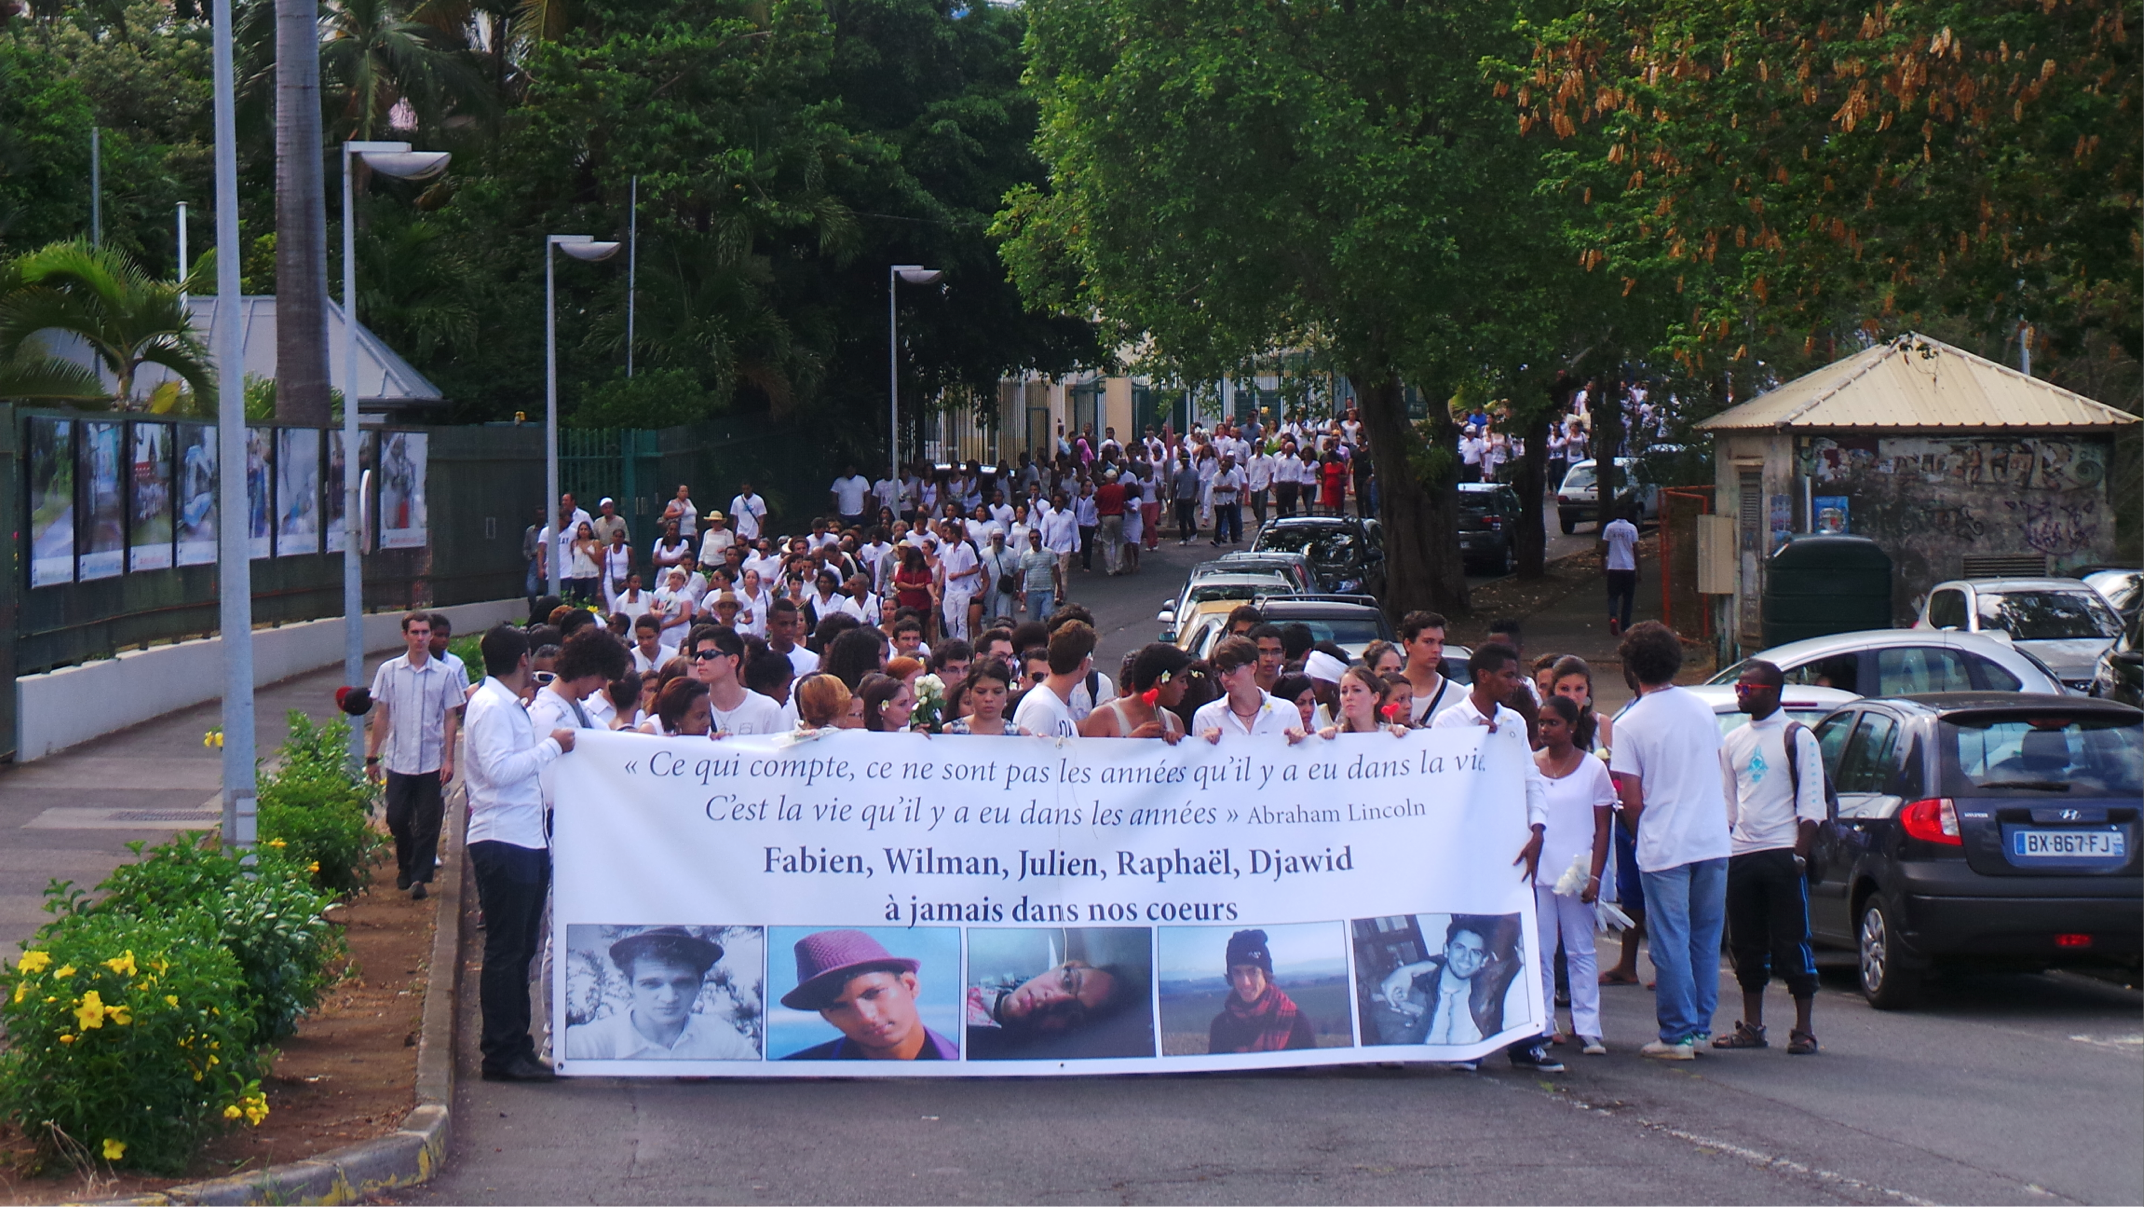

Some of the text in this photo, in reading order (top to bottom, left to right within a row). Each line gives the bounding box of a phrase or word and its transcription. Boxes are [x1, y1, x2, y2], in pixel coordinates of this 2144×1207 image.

[624, 761, 639, 775] «
[650, 751, 686, 777] Ce
[695, 753, 740, 785] qui
[749, 756, 856, 787] compte,
[867, 762, 893, 780] ce
[902, 762, 934, 781] ne
[942, 758, 997, 782] sont
[1004, 764, 1050, 790] pas
[1060, 756, 1091, 784] les
[1101, 757, 1187, 787] années
[1258, 764, 1275, 791] y
[1283, 764, 1299, 781] a
[1308, 762, 1338, 781] eu
[1347, 752, 1411, 780] dans
[1420, 749, 1445, 775] la
[705, 794, 768, 822] C’est
[777, 794, 803, 822] la
[812, 796, 853, 823] vie
[928, 805, 946, 832] y
[954, 806, 970, 824] a
[979, 806, 1011, 825] eu
[1020, 798, 1083, 826] dans
[1091, 799, 1124, 827] les
[1130, 800, 1217, 826] années
[1226, 808, 1239, 823] »
[1247, 804, 1341, 825] Abraham
[1347, 797, 1426, 822] Lincoln
[2027, 834, 2111, 853] BX-867-FJ
[764, 844, 1355, 884] Fabien, Wilman, Julien, Raphaël, Djawid
[884, 893, 1239, 929] à jamais dans nos coeurs
